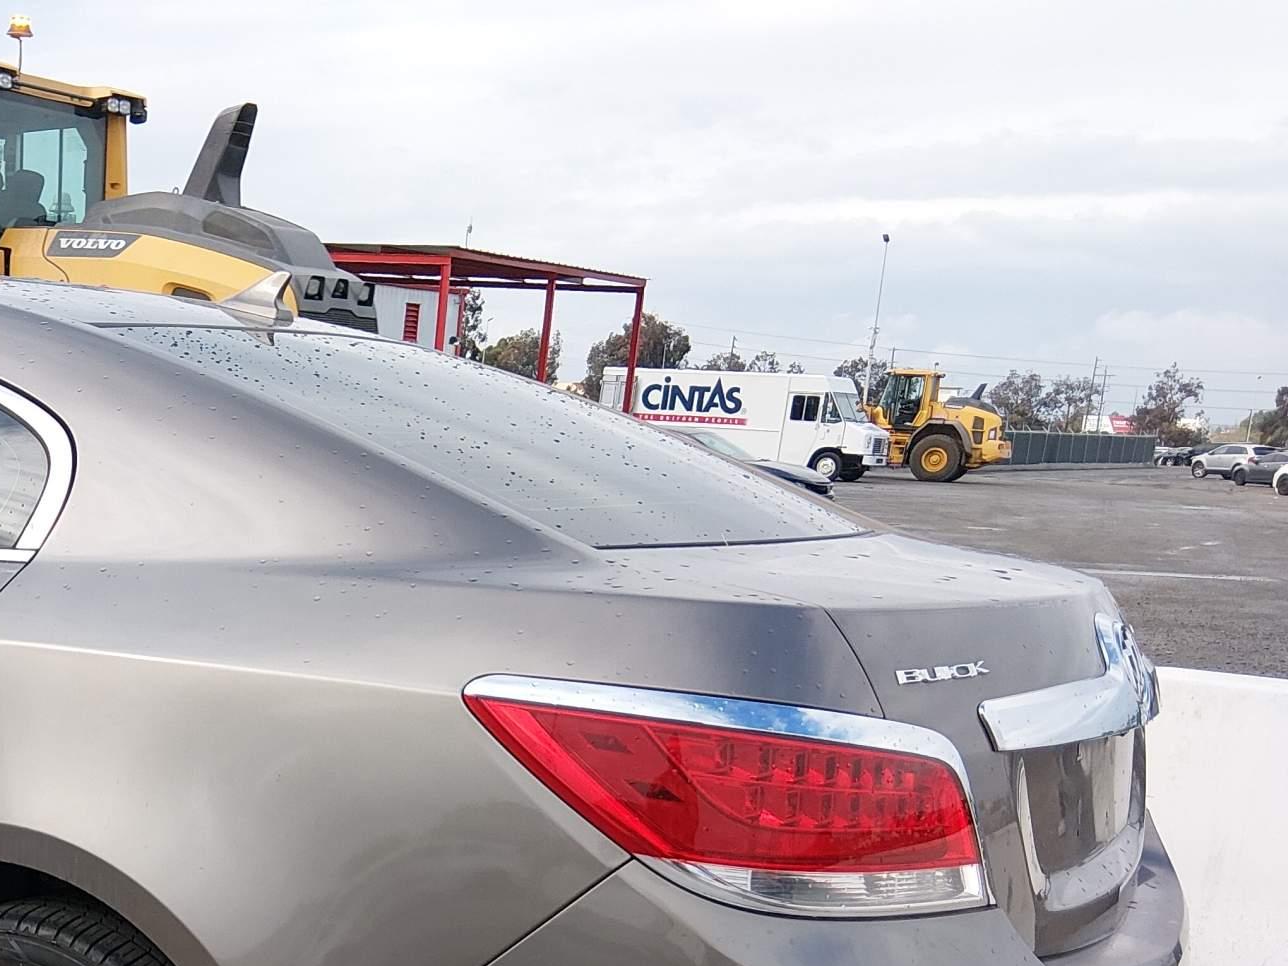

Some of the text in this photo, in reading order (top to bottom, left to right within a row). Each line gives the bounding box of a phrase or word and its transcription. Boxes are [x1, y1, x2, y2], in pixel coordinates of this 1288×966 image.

[58, 237, 127, 250] VOLVO
[659, 414, 701, 423] UNIFORM
[704, 416, 739, 425] PEOPLE
[895, 660, 991, 685] BUICK
